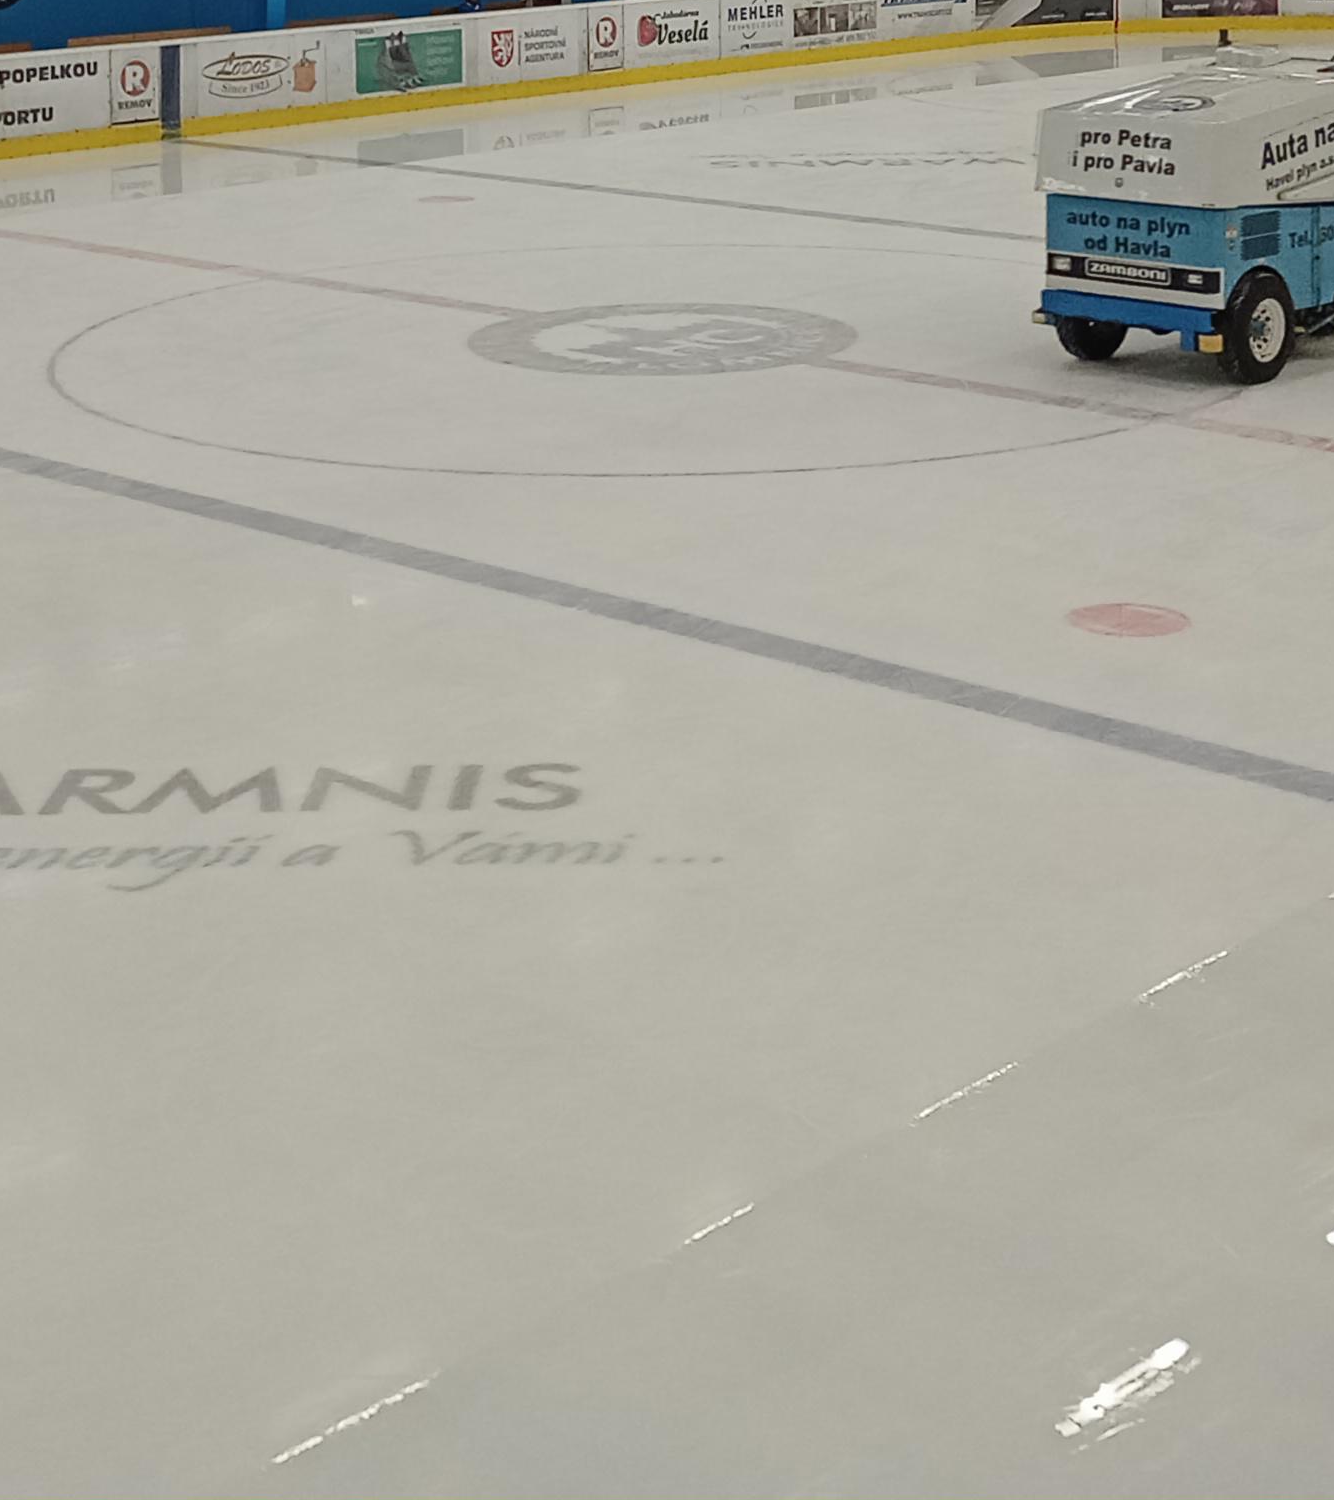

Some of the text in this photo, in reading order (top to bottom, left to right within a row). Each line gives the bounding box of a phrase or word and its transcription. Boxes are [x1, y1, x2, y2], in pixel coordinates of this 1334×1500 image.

[727, 4, 784, 22] MEHLER
[658, 20, 708, 46] Veselá
[0, 61, 98, 85] POPELKOU
[1080, 129, 1172, 150] pro Petra
[1261, 134, 1308, 170] Auta
[1072, 150, 1175, 176] i pro Pavla
[1067, 212, 1190, 238] auto na plyn
[1084, 236, 1171, 258] od Havla
[1090, 262, 1166, 281] ZAMBONI
[279, 844, 343, 867] a
[386, 830, 640, 866] Vámi
